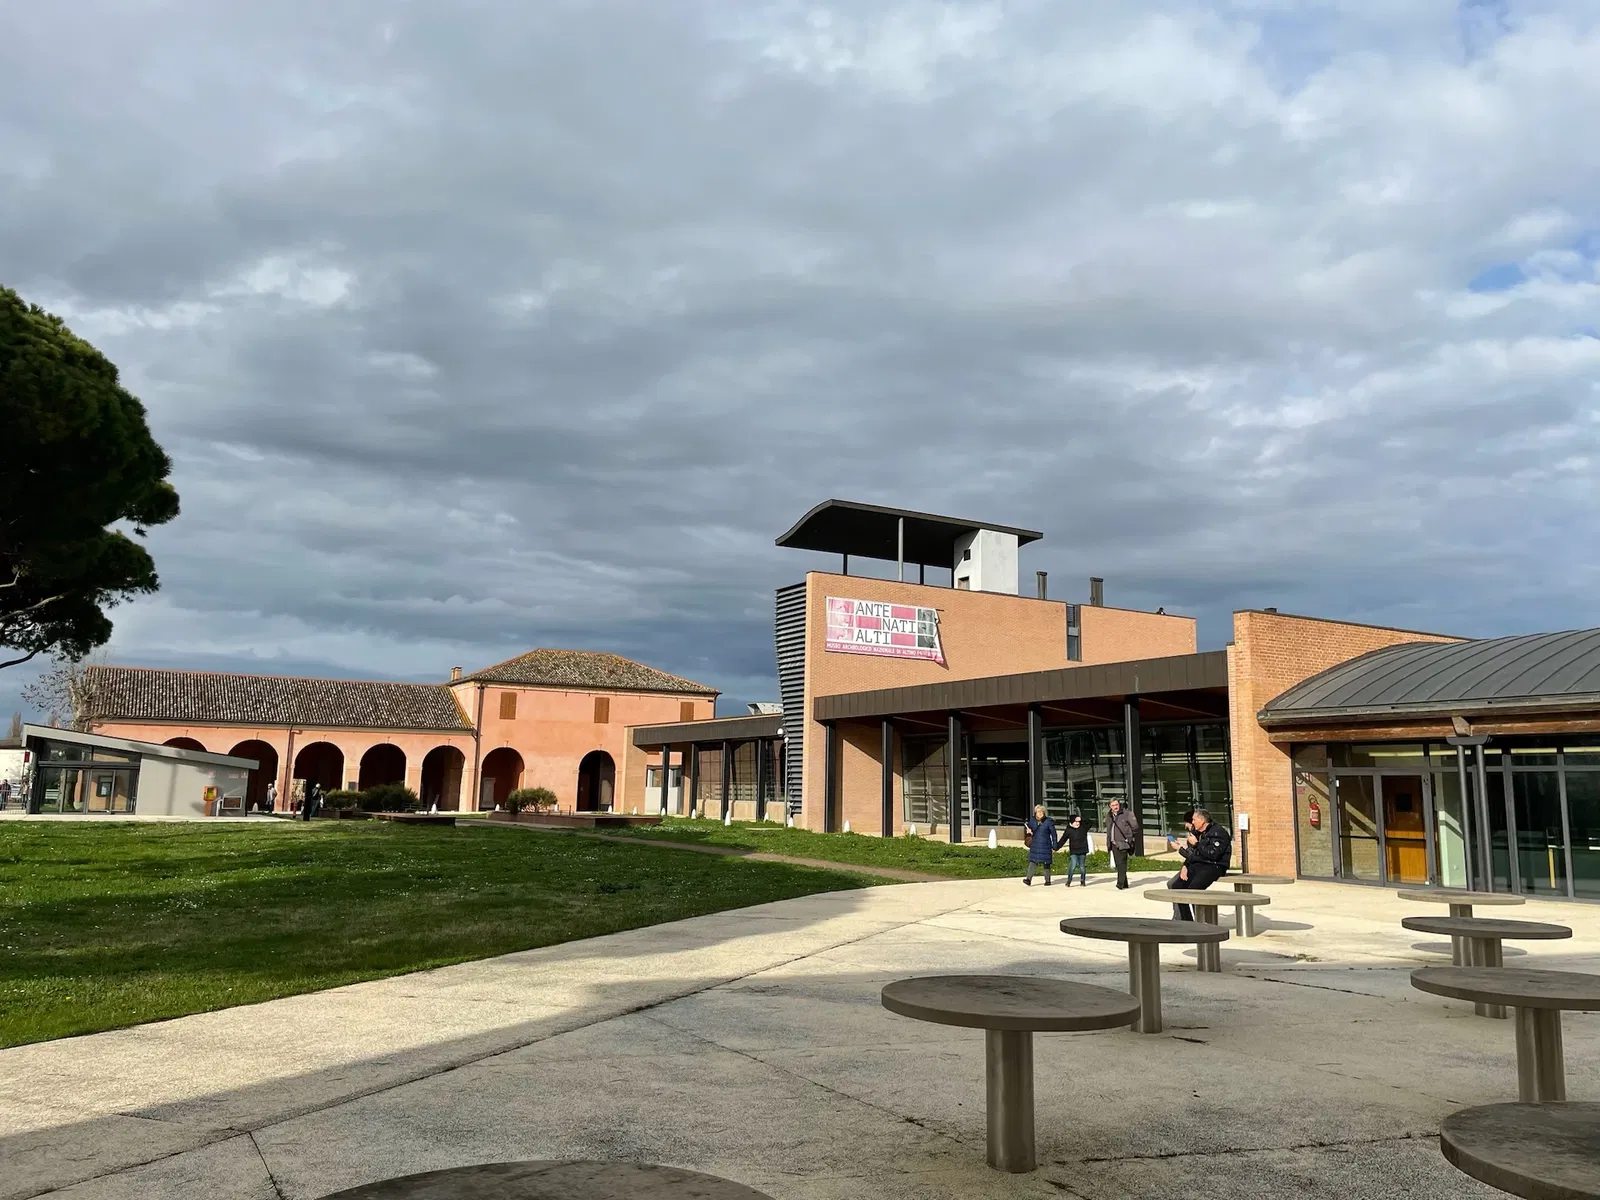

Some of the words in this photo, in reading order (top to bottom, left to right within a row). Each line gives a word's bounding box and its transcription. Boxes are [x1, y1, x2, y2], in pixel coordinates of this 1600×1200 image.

[855, 602, 890, 617] ANTE
[882, 618, 916, 634] NATI
[855, 629, 890, 645] ALTI
[842, 643, 872, 652] ARCHEOLOGICO
